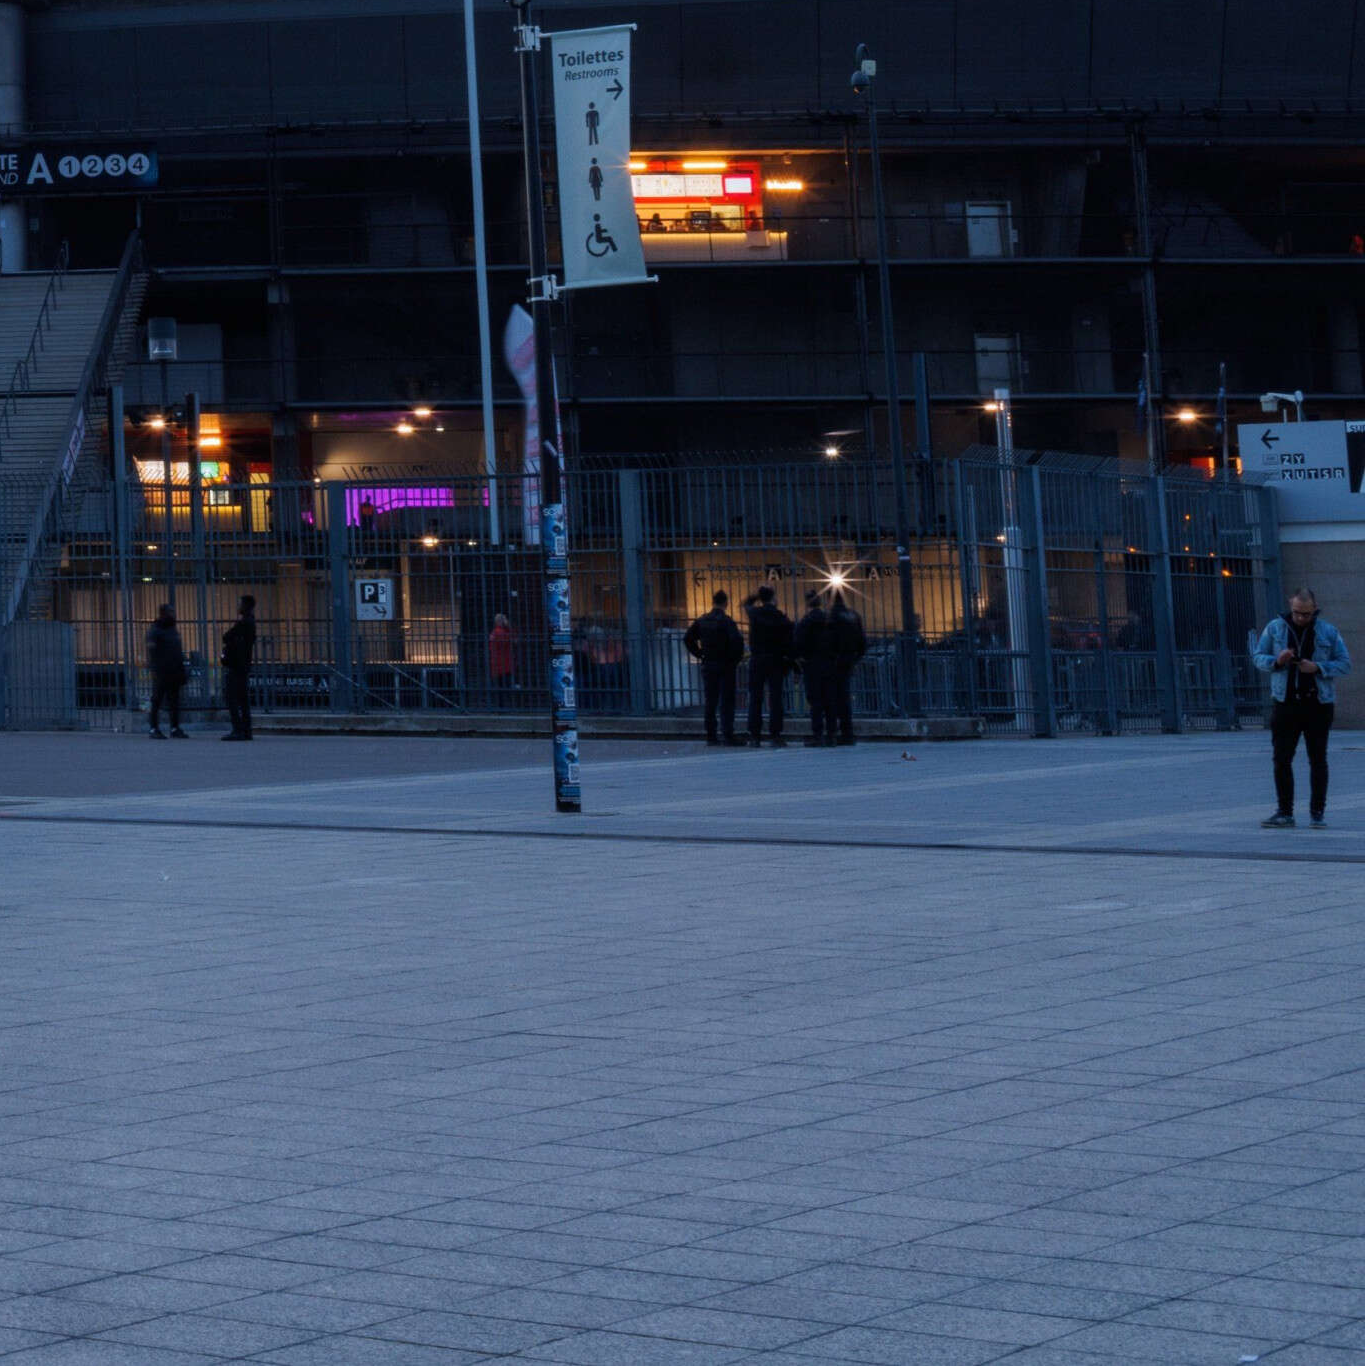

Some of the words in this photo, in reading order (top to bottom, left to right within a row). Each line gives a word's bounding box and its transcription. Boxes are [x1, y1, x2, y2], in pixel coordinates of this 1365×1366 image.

[558, 50, 624, 67] Toilettes
[565, 67, 619, 81] Restrooms
[26, 152, 54, 184] A
